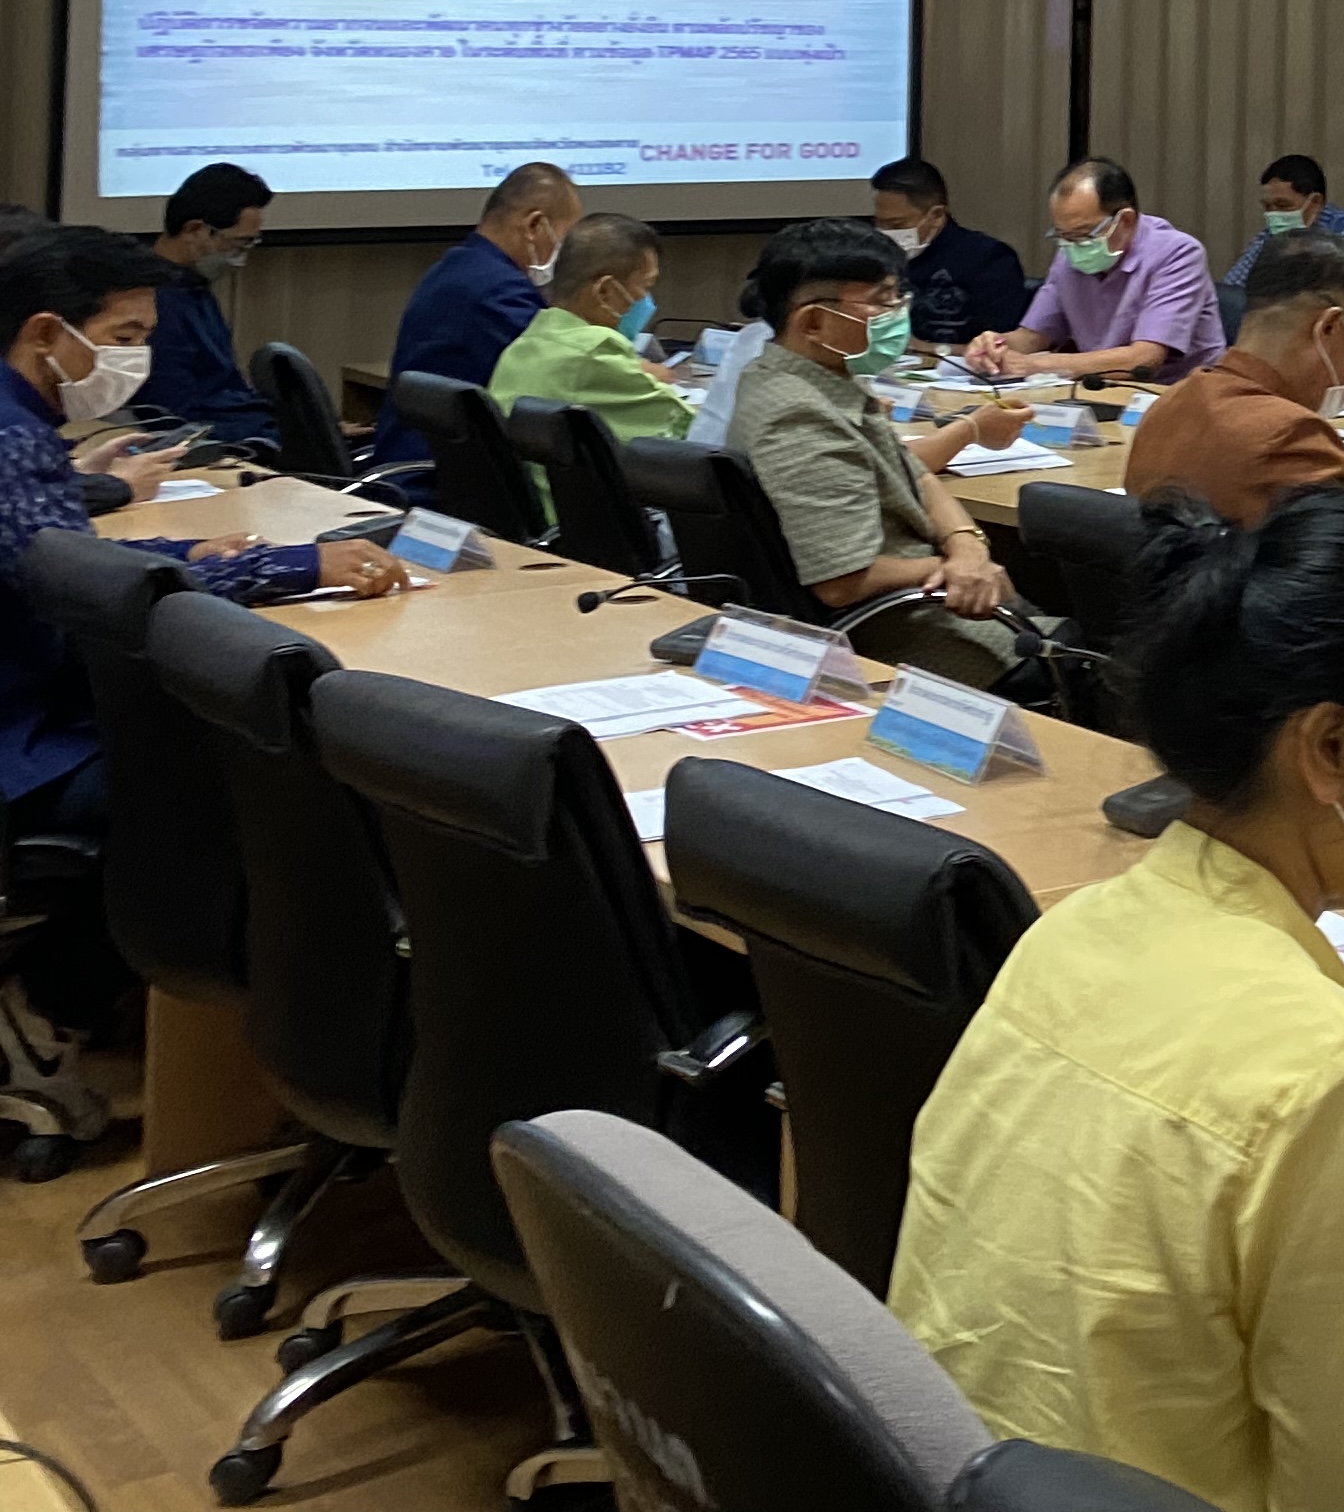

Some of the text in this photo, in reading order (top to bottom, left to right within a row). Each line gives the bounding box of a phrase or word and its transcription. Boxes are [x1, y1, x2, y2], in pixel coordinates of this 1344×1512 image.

[639, 141, 861, 161] CHANGE FOR GOOD
